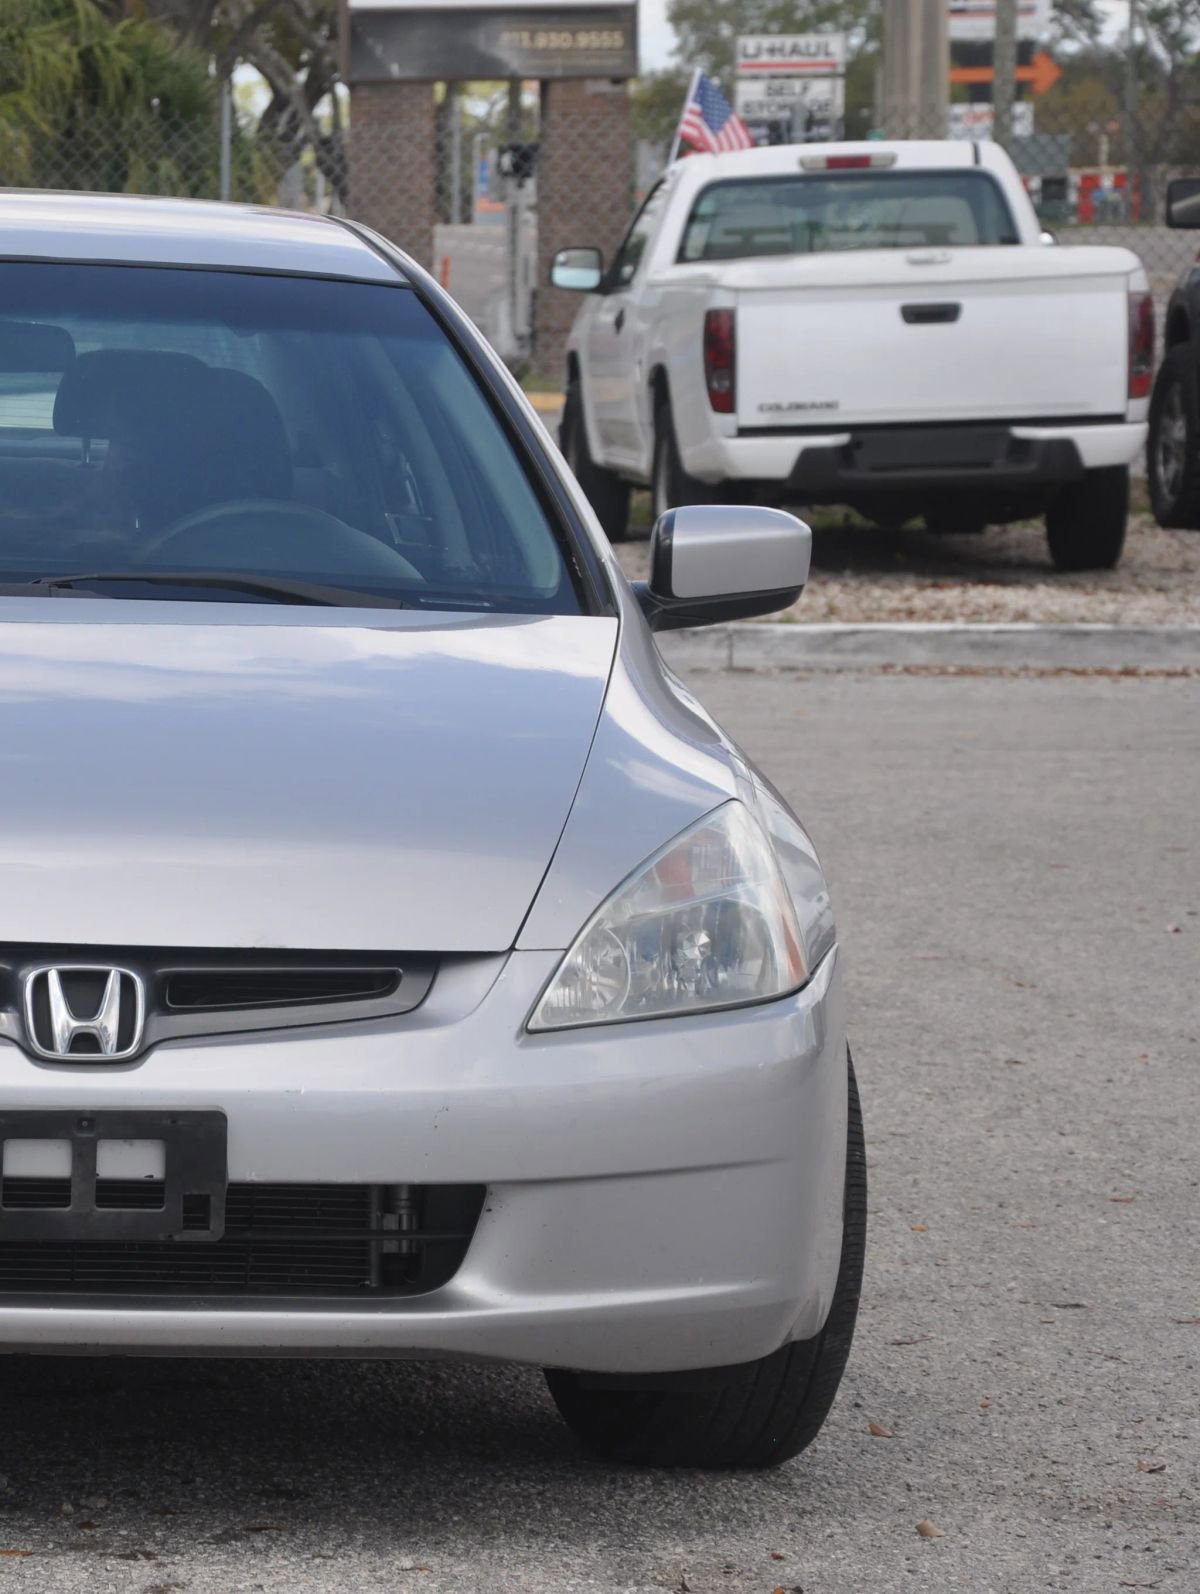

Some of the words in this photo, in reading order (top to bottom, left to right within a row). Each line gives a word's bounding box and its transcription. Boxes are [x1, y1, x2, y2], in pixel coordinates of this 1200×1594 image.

[742, 40, 835, 58] U-HAUL
[765, 81, 810, 97] SELF
[742, 100, 834, 116] STORGE
